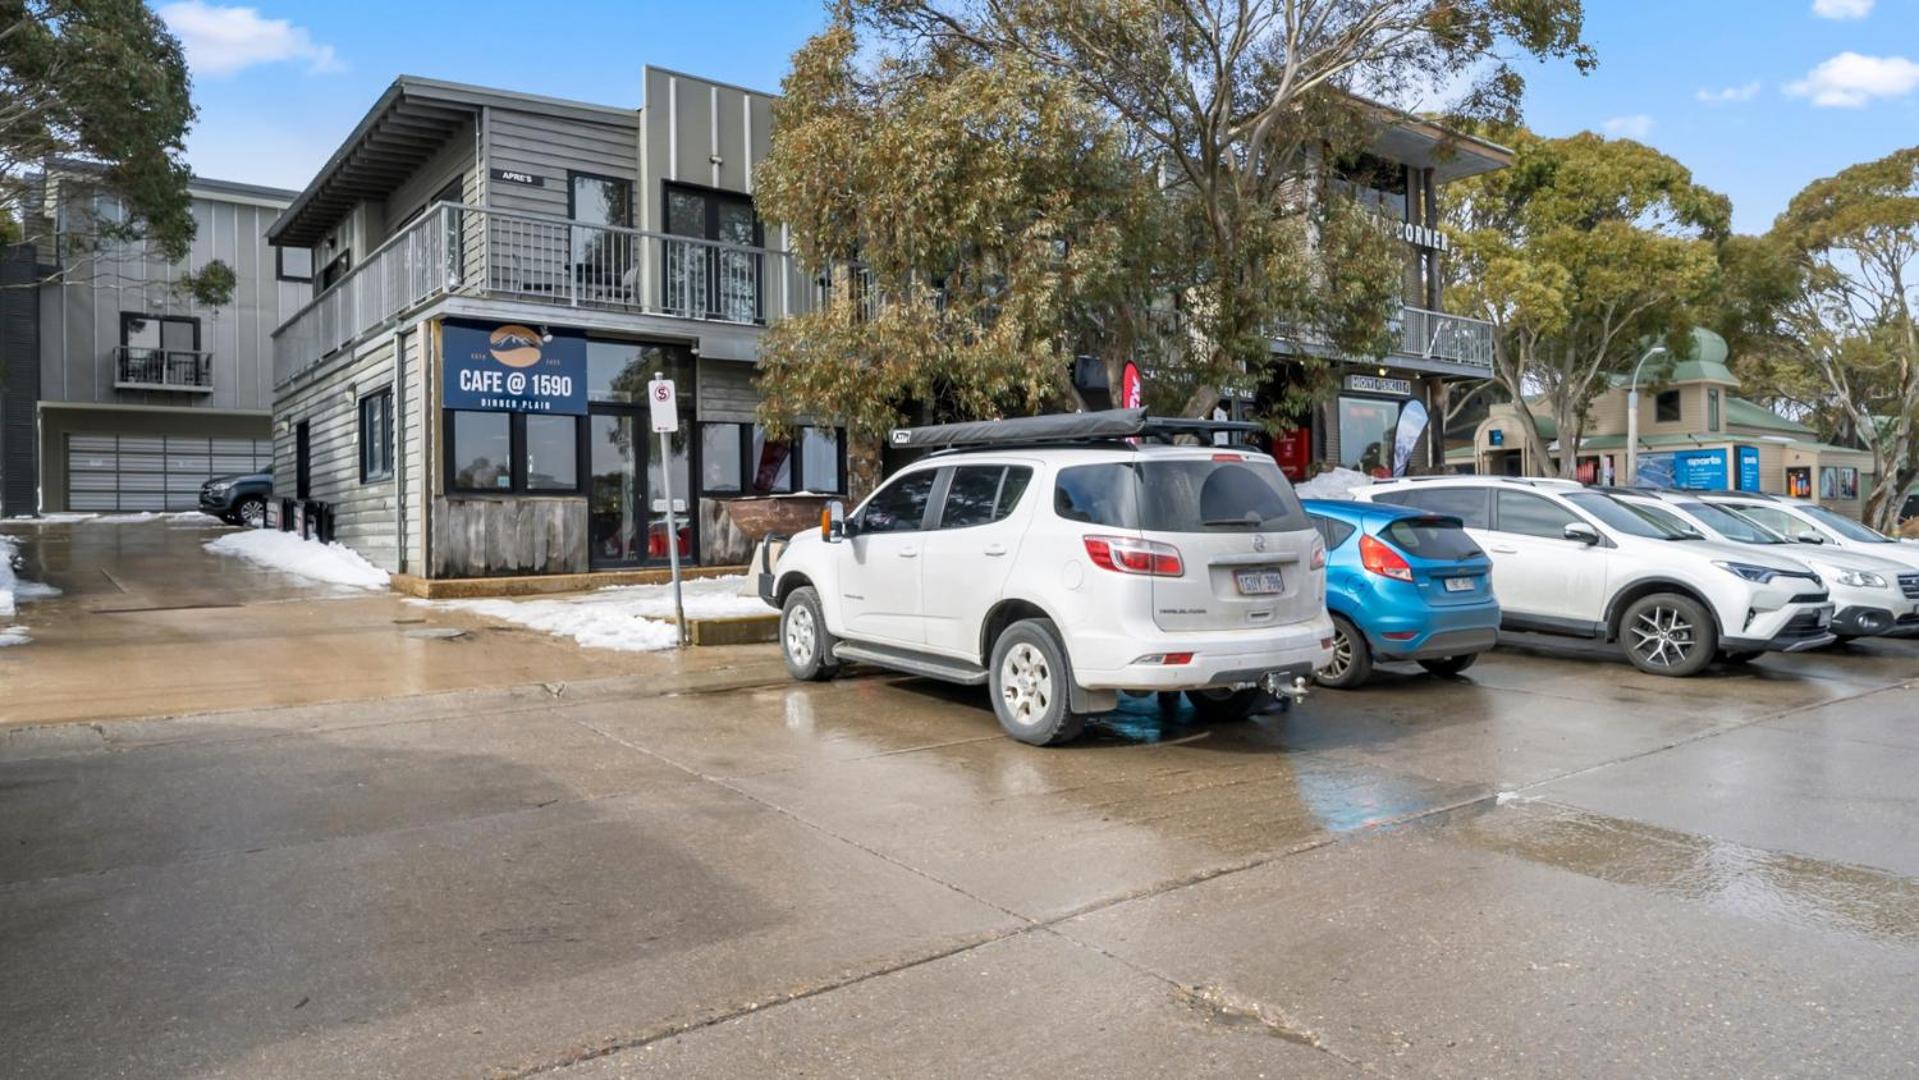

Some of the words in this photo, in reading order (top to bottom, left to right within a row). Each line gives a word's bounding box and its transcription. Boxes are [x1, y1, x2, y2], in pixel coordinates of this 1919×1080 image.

[460, 369, 503, 393] CAFE
[507, 372, 526, 395] @
[532, 374, 573, 397] 1590
[481, 398, 517, 409] DINNER
[522, 400, 551, 411] PLAIN
